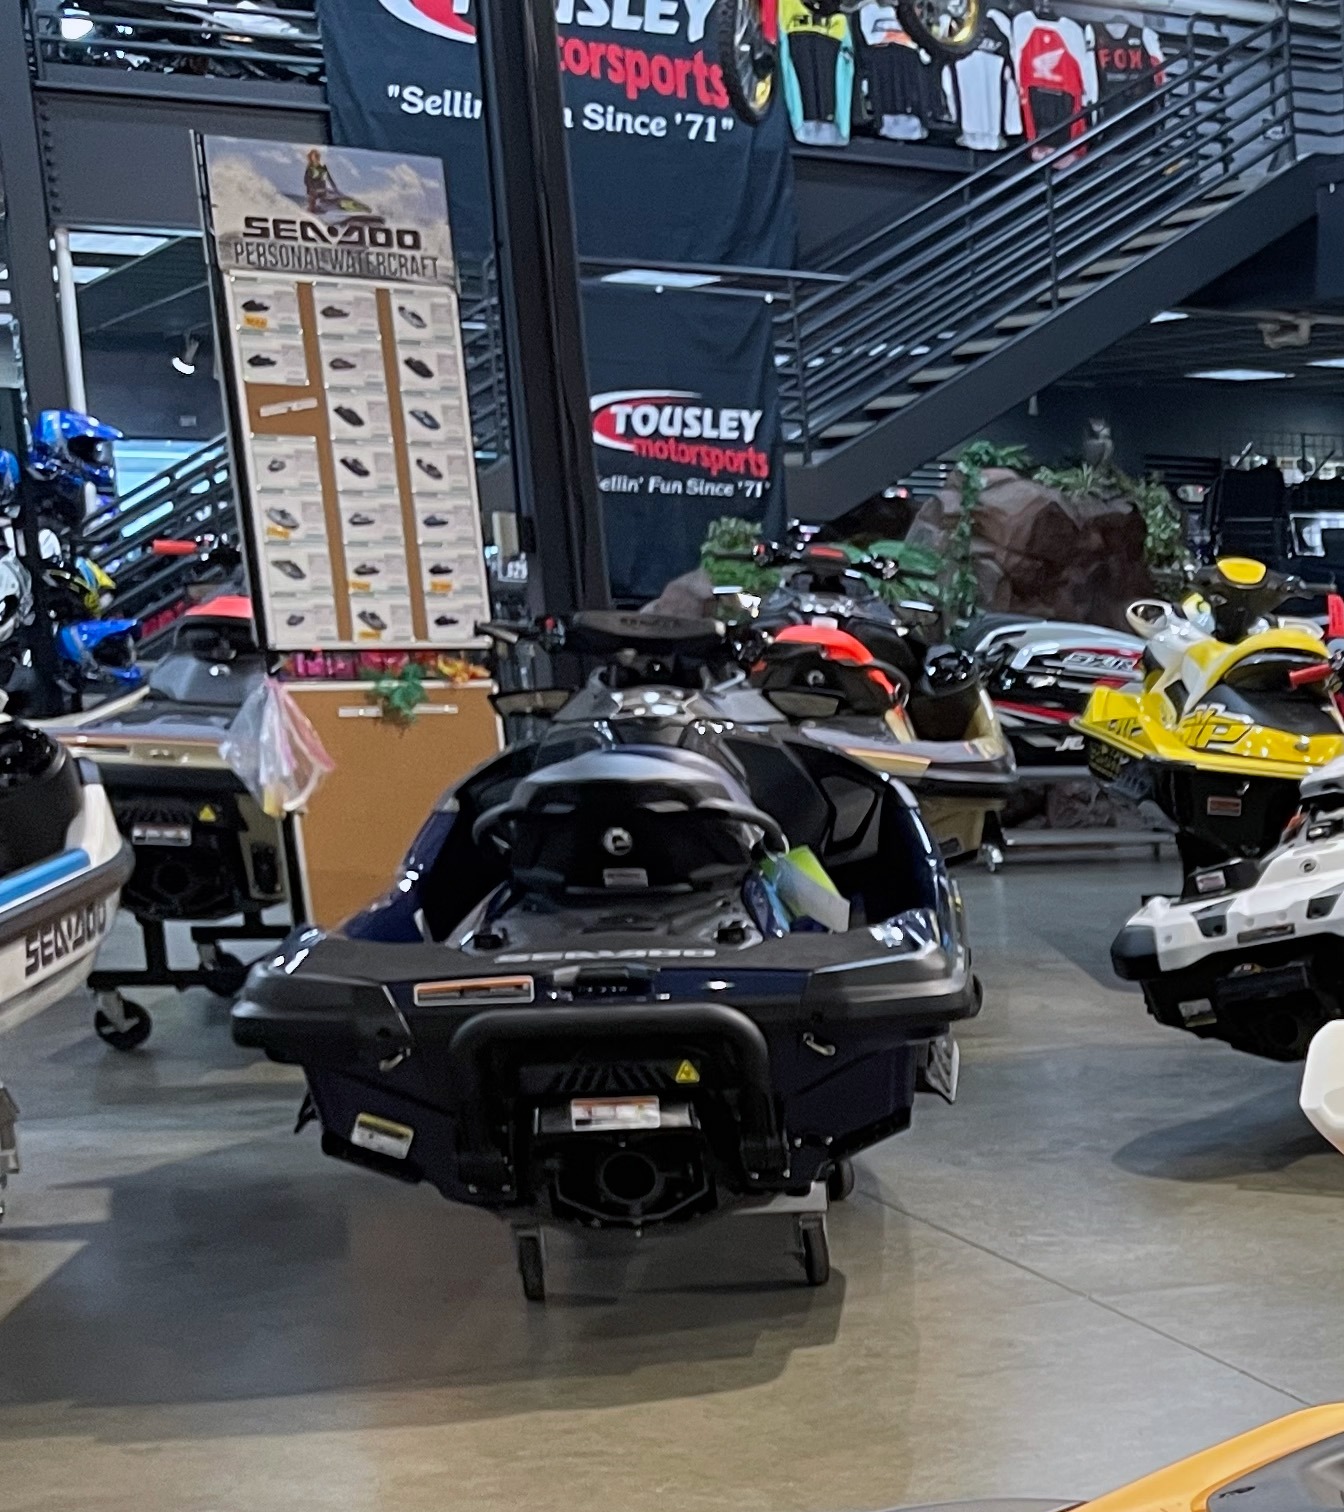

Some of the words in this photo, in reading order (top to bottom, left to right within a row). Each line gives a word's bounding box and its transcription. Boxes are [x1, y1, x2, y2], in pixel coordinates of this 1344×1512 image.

[1099, 48, 1142, 70] FOX
[582, 103, 667, 137] Since
[233, 241, 326, 274] PERSONAL
[328, 247, 438, 280] WATERCRAFT
[610, 404, 763, 444] TOUSLEY
[633, 437, 770, 480] motorsports
[600, 474, 645, 494] ellin'
[648, 475, 682, 495] Fun
[686, 477, 734, 497] Since
